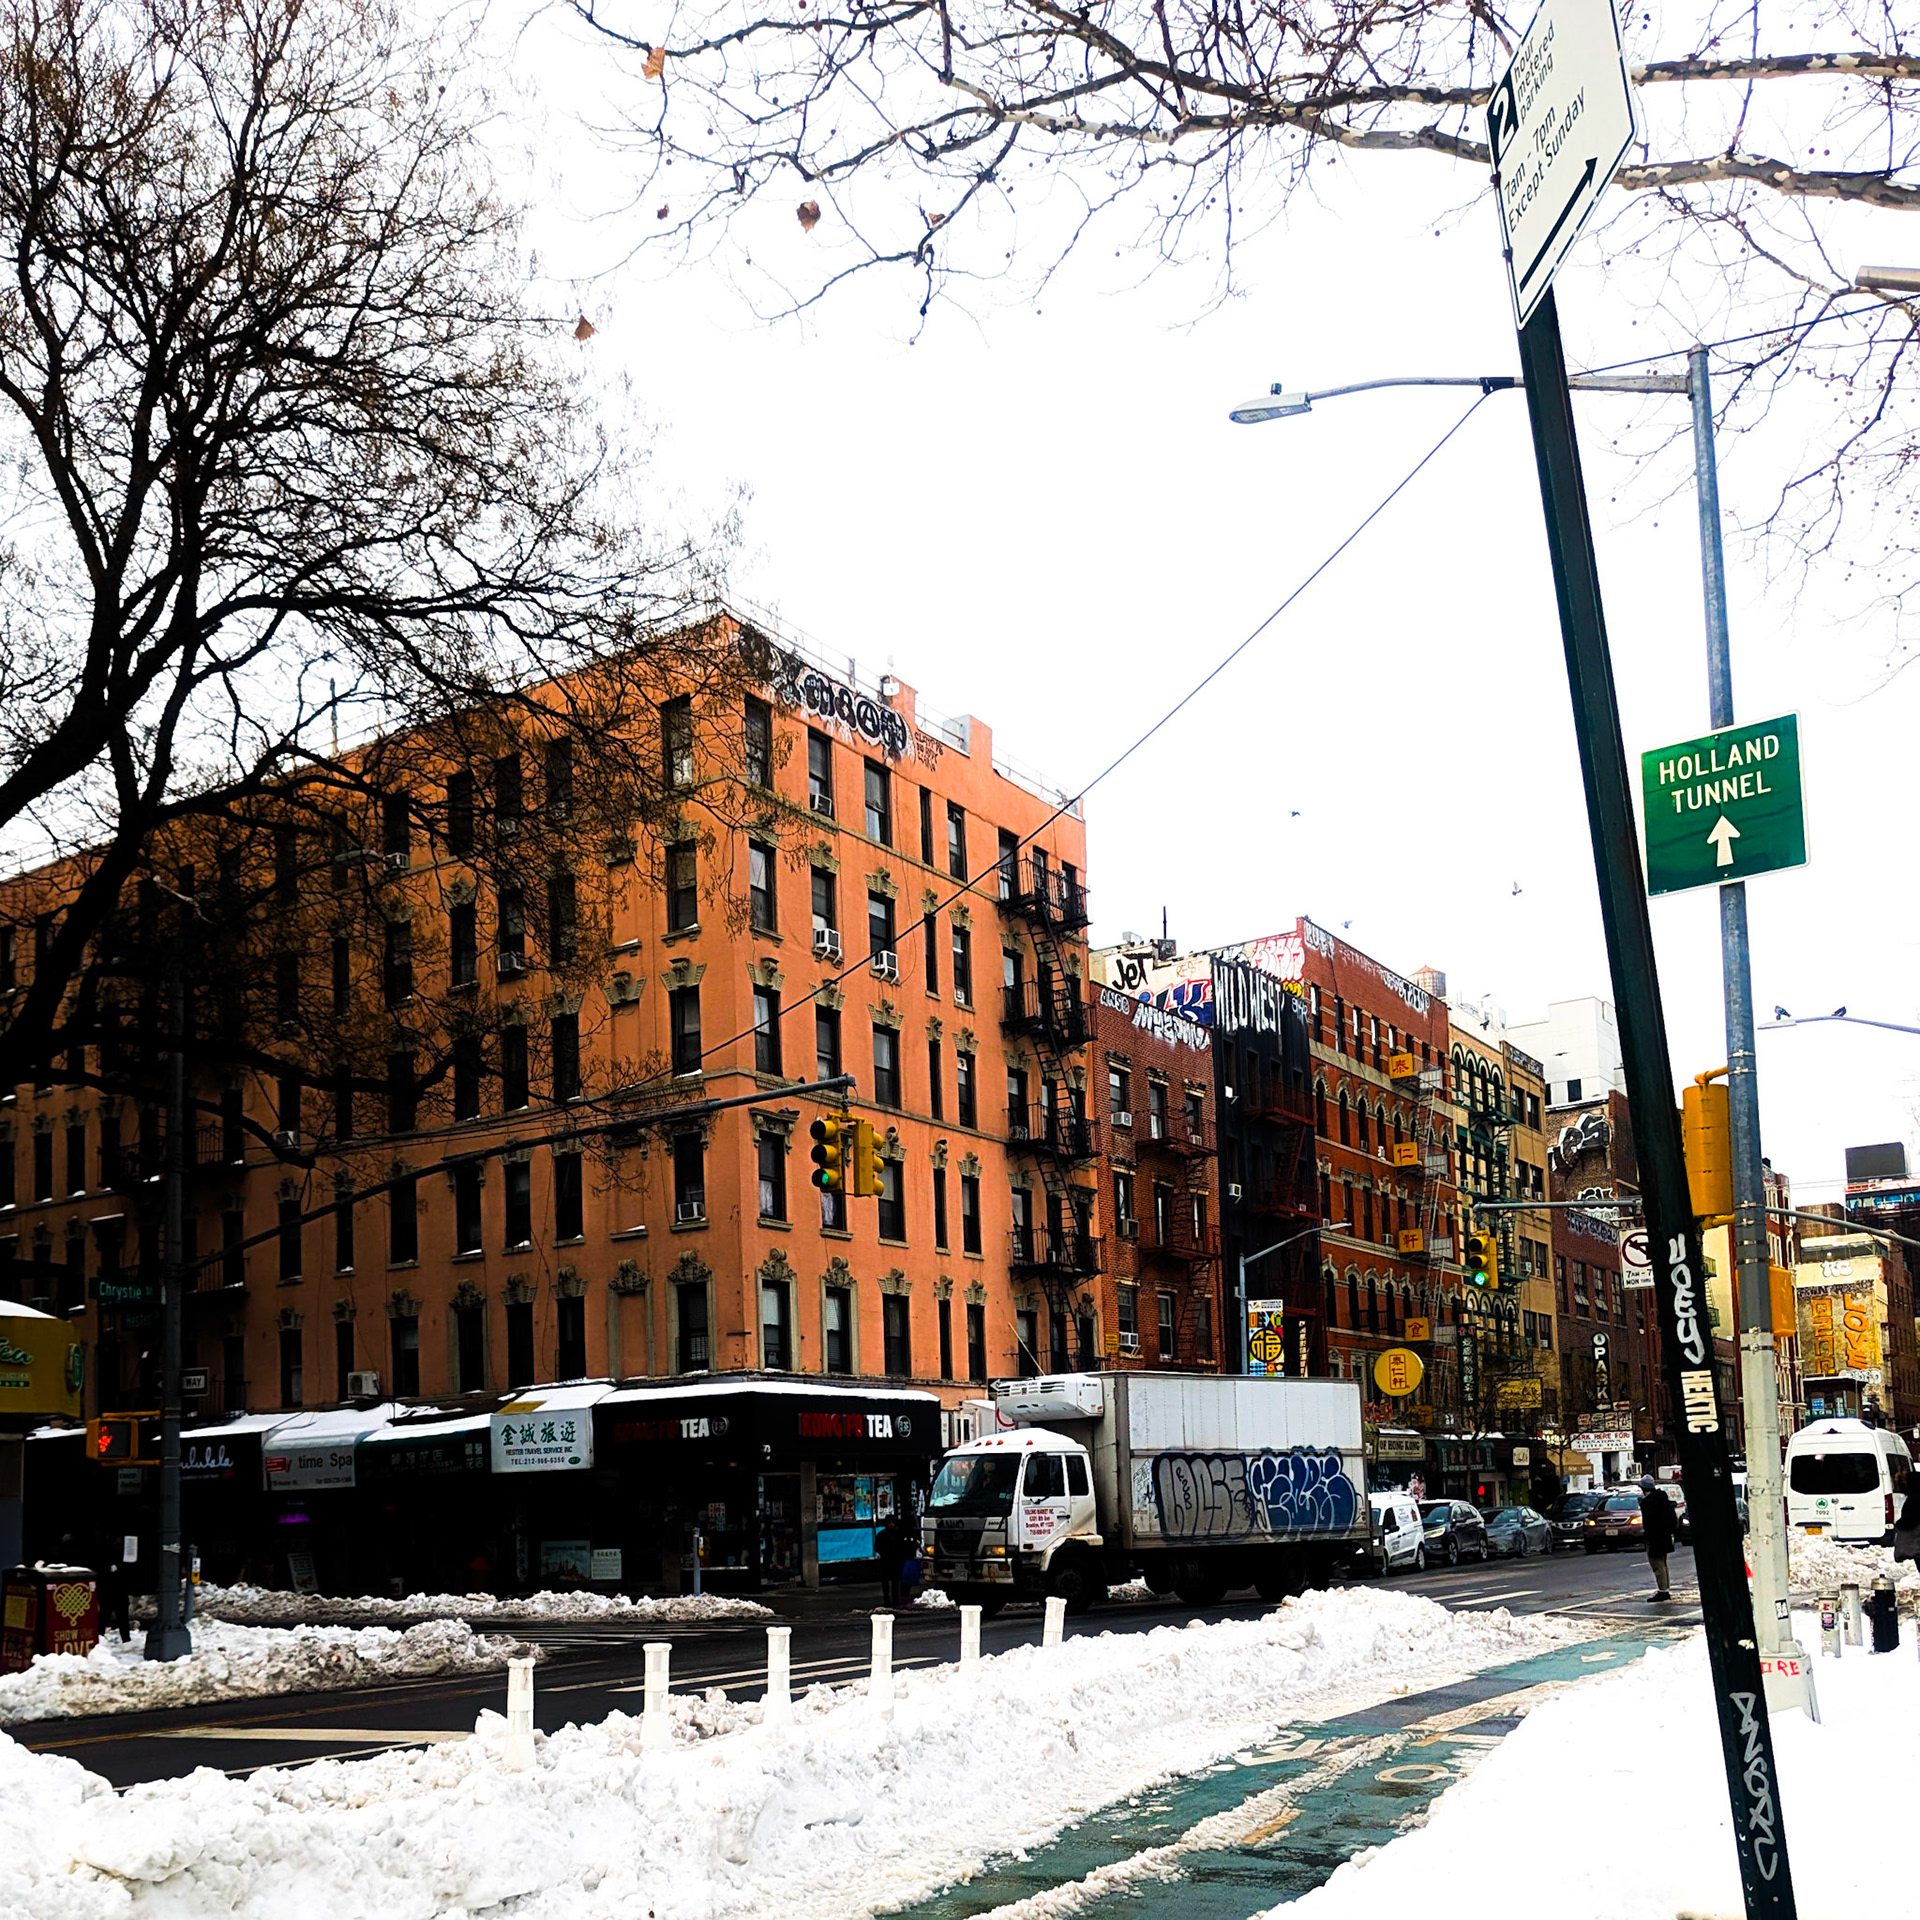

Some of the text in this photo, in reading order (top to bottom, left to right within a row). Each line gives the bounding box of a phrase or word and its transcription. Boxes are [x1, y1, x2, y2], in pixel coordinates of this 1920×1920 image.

[1513, 36, 1535, 84] hour
[1516, 19, 1555, 103] metered
[1520, 53, 1554, 125] parking
[1492, 86, 1518, 162] 2
[1504, 162, 1526, 205] 7am
[1532, 106, 1556, 154] 7pm
[1508, 86, 1585, 233] Except Sunday
[1658, 734, 1780, 785] HOLLAND
[1671, 771, 1772, 814] TUNNEL
[1396, 1148, 1414, 1162] 仁
[99, 1281, 143, 1303] Chrystie
[1251, 1329, 1282, 1361] 福
[185, 1377, 202, 1387] WAY
[1594, 1346, 1609, 1400] PARK
[1680, 1369, 1719, 1434] HEKTIC
[501, 1421, 576, 1446] 金誠旅遊
[680, 1417, 710, 1439] TEA
[801, 1413, 893, 1438] KUNG FU TEA
[298, 1454, 323, 1469] time
[330, 1452, 352, 1470] Spa
[506, 1448, 524, 1456] HESTER
[524, 1447, 542, 1455] TRAVEL
[543, 1446, 563, 1454] SERVICE
[1388, 1440, 1403, 1450] HONG
[1405, 1440, 1420, 1451] KONG
[53, 1629, 78, 1642] SHOW
